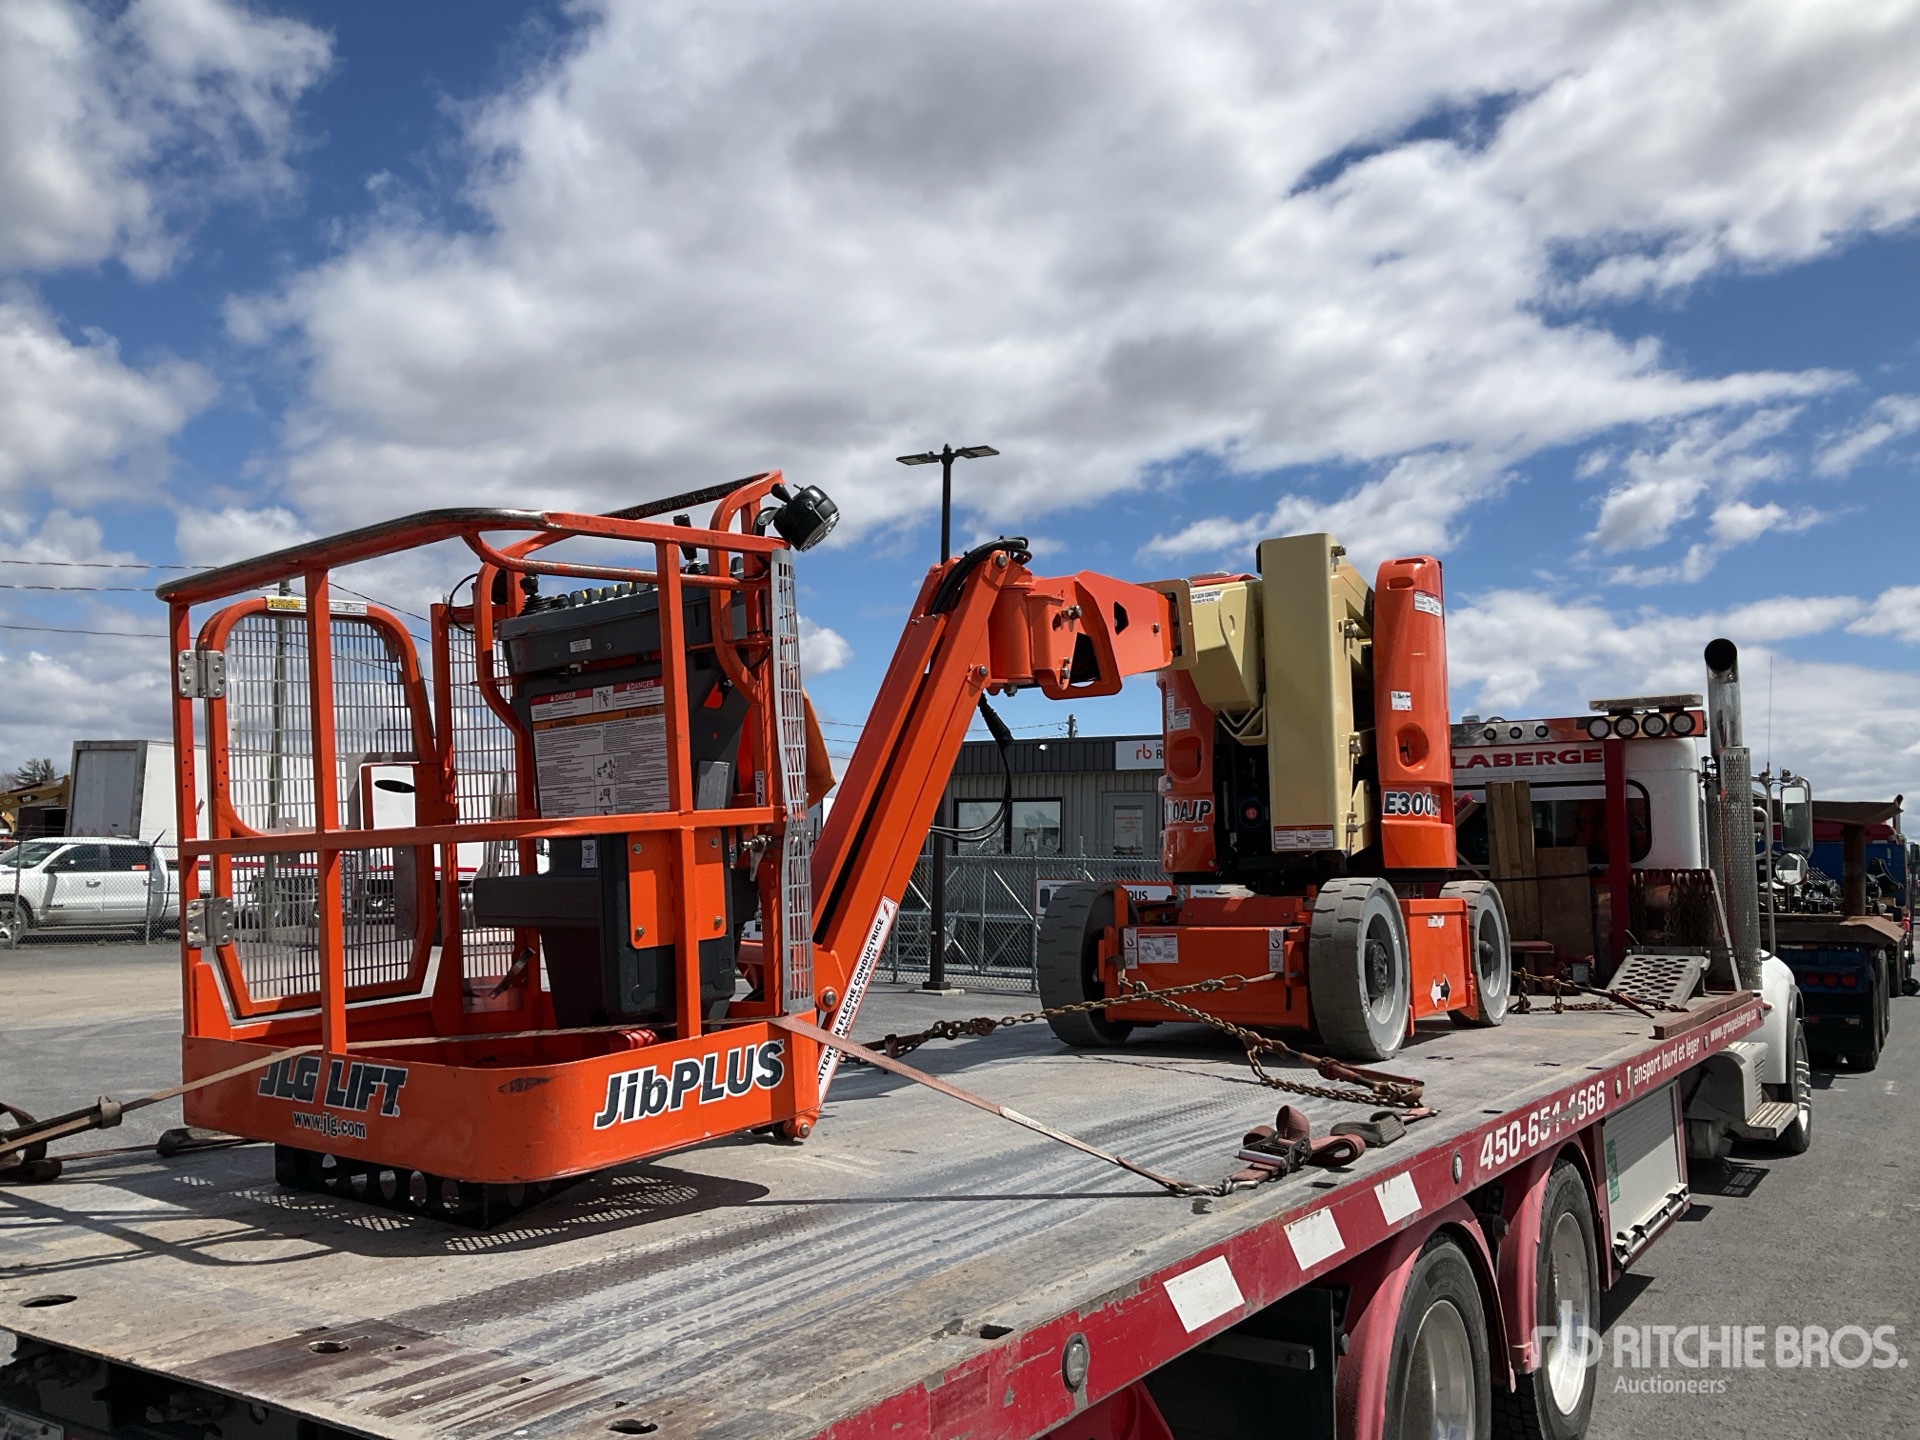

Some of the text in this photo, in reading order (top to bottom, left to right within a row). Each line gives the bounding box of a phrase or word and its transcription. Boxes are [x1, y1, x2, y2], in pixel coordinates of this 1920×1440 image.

[555, 692, 576, 701] DANGER
[631, 680, 654, 689] DANGER
[1136, 742, 1152, 760] rb
[1451, 749, 1603, 769] LABERGE
[1382, 791, 1440, 817] E300
[853, 918, 884, 986] CONDUCTRICE
[1710, 1008, 1757, 1042] www.groupelaberge.ca
[1626, 1035, 1700, 1089] Tansport lourd et léger
[258, 1055, 408, 1116] JLG LIFT
[593, 1039, 785, 1130] JibPLUS
[293, 1111, 367, 1139] www.jlg.com
